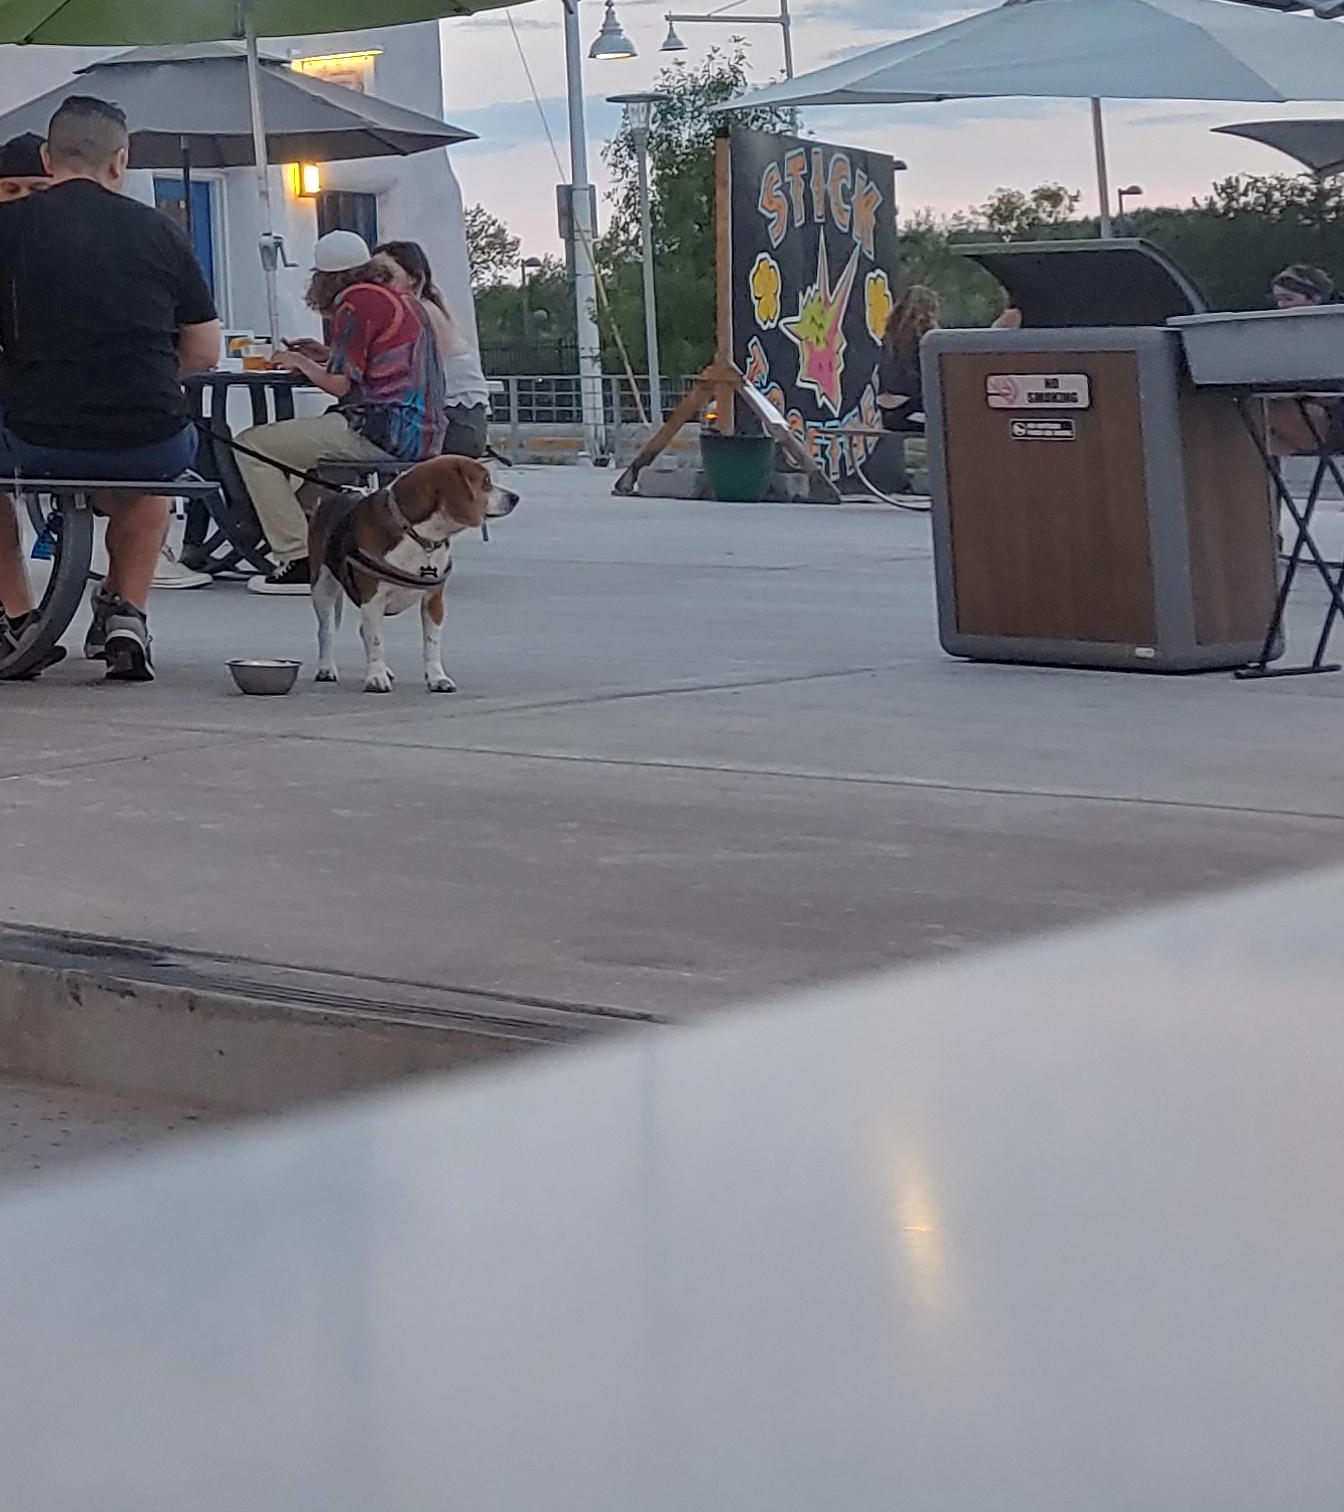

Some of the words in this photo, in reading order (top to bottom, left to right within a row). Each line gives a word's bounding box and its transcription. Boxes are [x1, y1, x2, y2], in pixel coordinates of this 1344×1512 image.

[758, 147, 883, 260] STICK
[1044, 378, 1059, 389] NO
[1027, 392, 1078, 403] SMOKING
